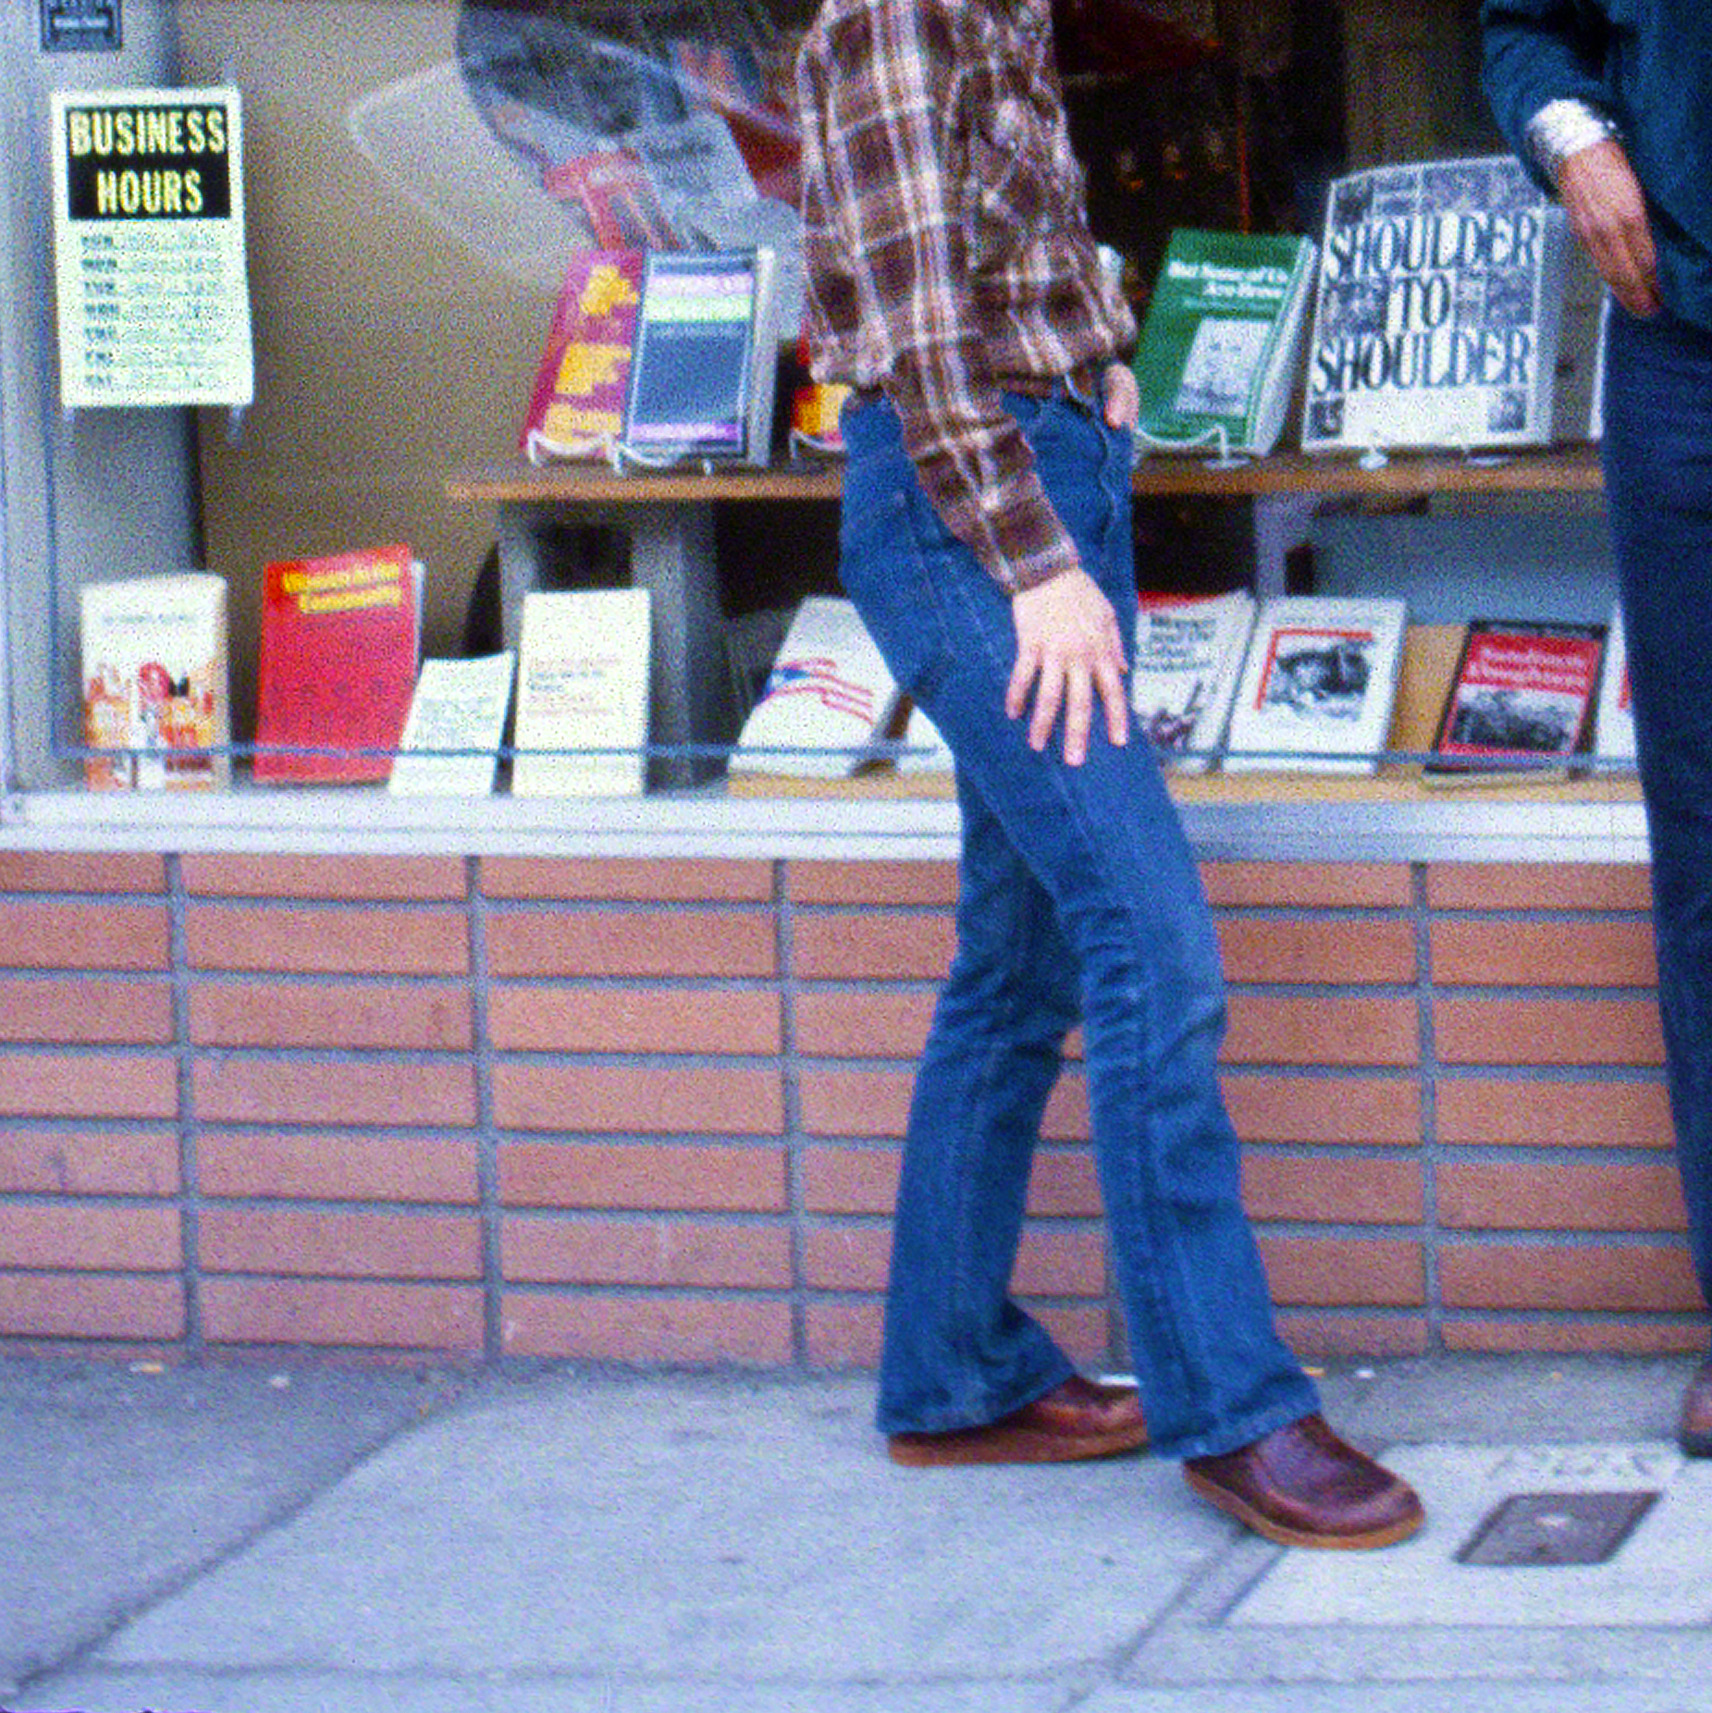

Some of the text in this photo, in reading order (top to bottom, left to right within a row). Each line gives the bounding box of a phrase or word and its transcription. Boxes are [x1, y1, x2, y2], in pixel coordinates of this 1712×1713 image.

[69, 109, 227, 157] BUSINESS
[97, 168, 204, 215] HOURS
[1329, 208, 1538, 280] SHOULDER
[1395, 273, 1452, 330] TO
[1313, 326, 1531, 395] SHOULDER
